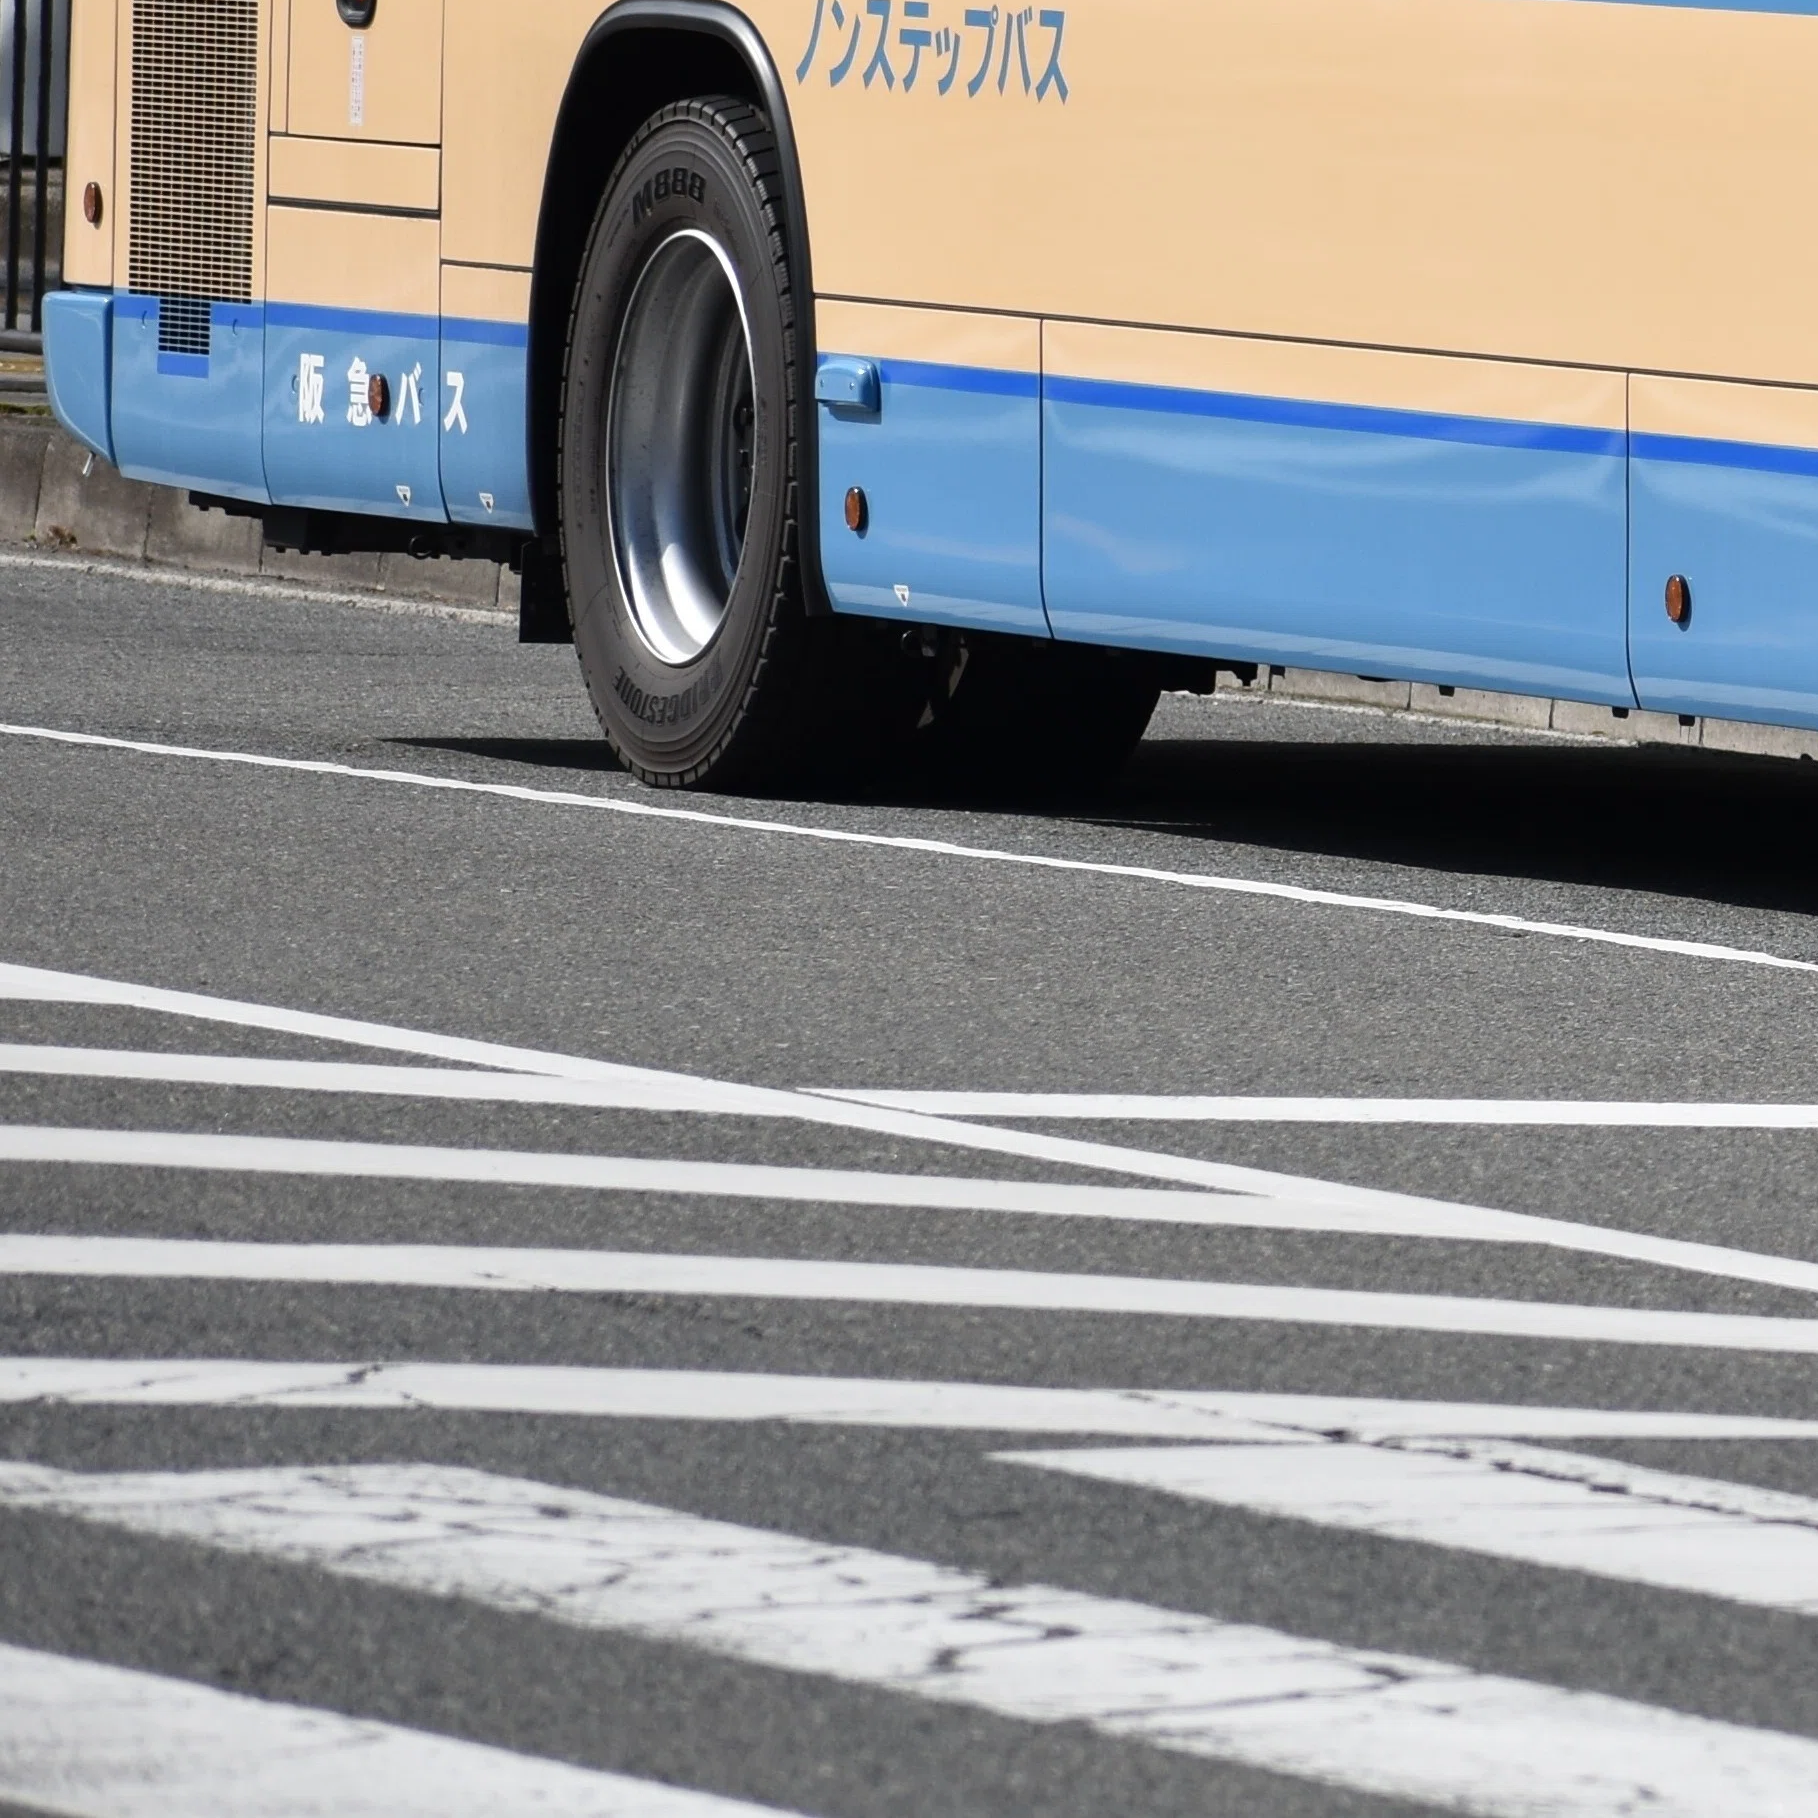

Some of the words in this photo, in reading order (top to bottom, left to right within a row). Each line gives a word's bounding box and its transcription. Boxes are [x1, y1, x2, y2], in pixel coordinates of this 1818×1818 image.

[632, 167, 707, 227] M888
[299, 353, 468, 435] 阪急バス
